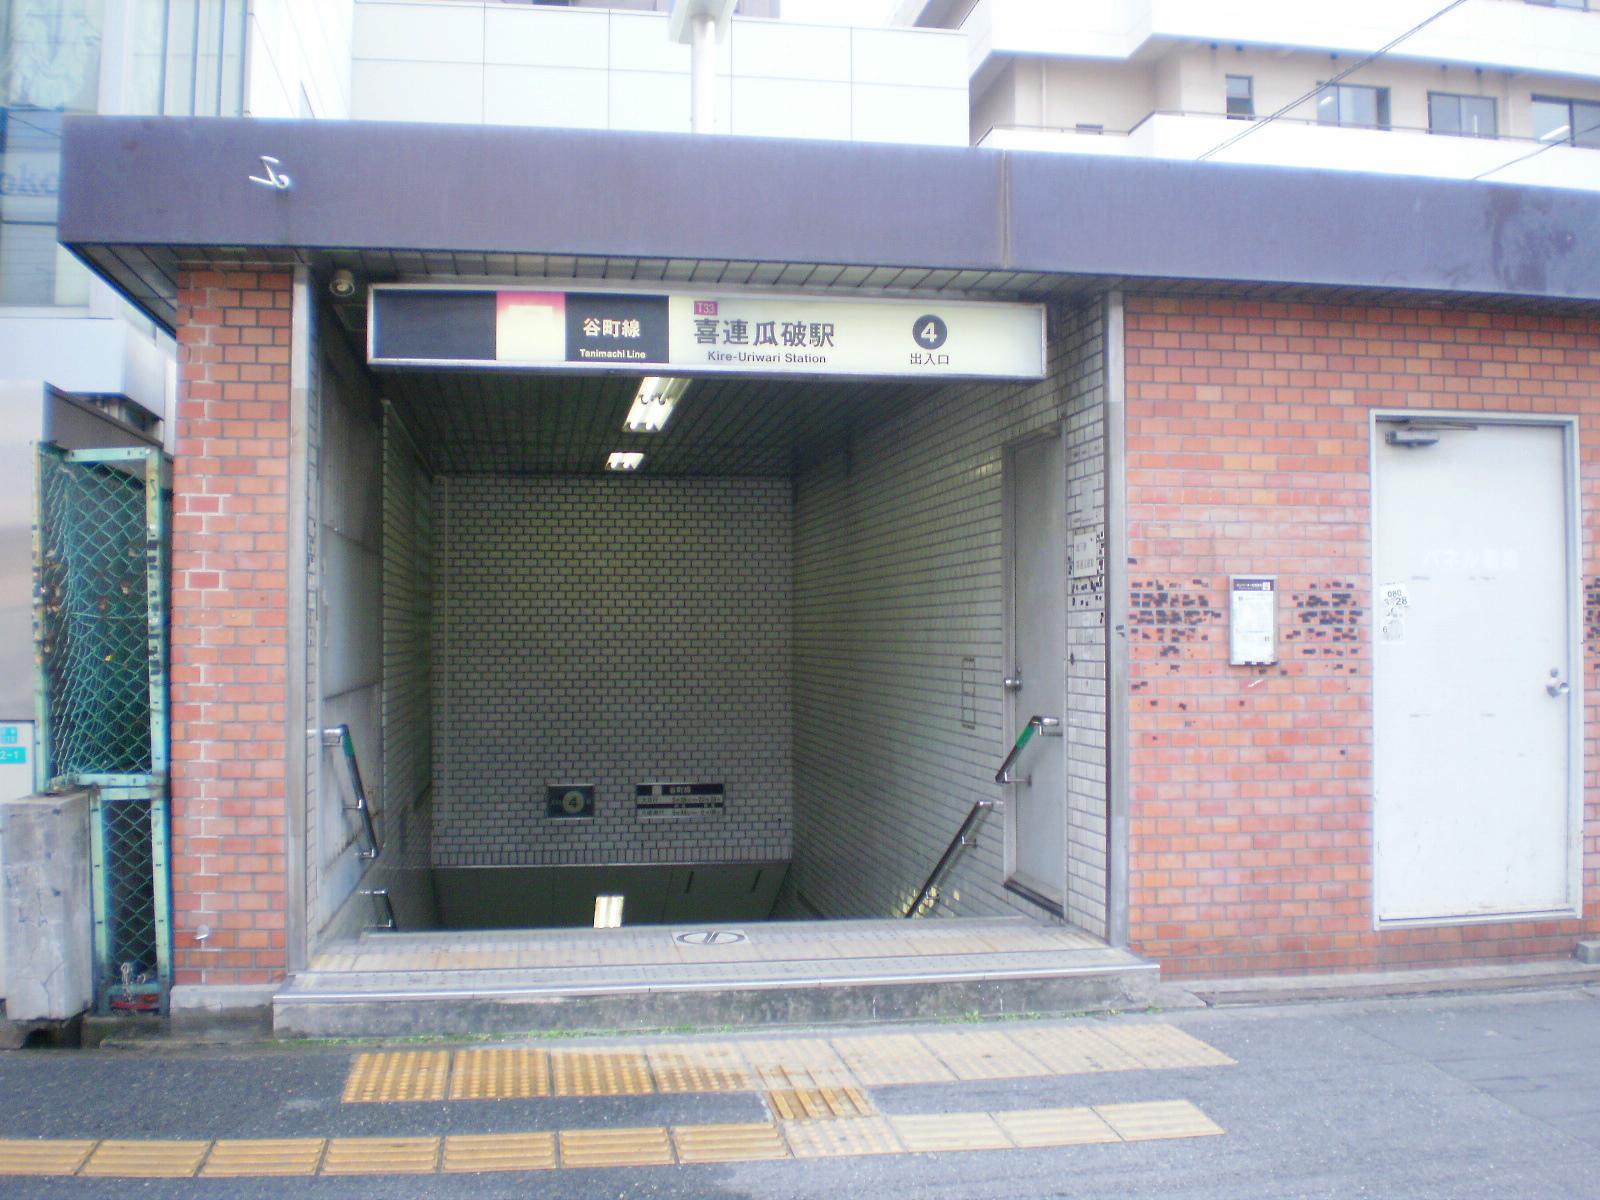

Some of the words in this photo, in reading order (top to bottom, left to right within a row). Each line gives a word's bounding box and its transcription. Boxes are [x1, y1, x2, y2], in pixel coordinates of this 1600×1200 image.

[697, 303, 716, 315] T33
[583, 318, 641, 338] 谷町線
[693, 318, 835, 347] 喜連瓜破駅
[579, 348, 625, 359] Tanimachi
[626, 349, 646, 360] Line
[707, 351, 781, 363] Kire-Uriwari
[784, 353, 827, 364] Station
[910, 352, 949, 365] 出入口
